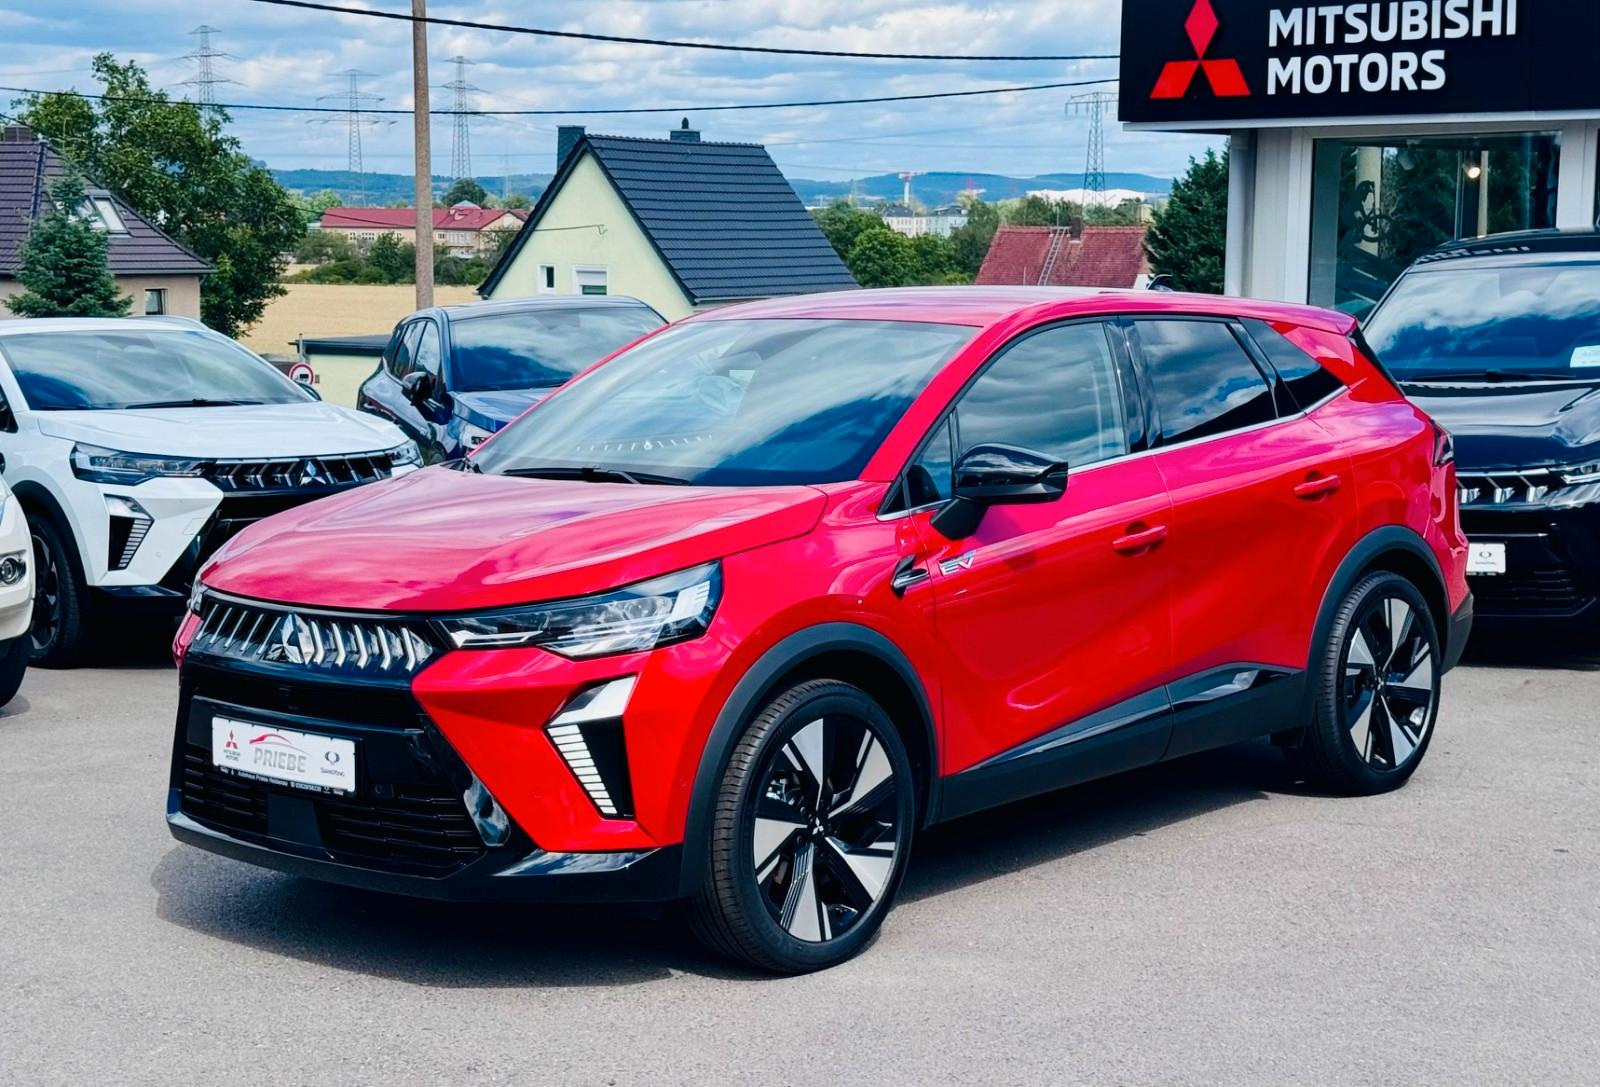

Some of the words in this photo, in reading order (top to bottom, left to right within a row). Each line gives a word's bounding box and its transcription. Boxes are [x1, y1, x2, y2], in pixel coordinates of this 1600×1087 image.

[1268, 0, 1517, 47] MITSUBISHI
[1267, 50, 1446, 95] MOTORS
[253, 747, 307, 773] PRIEBE
